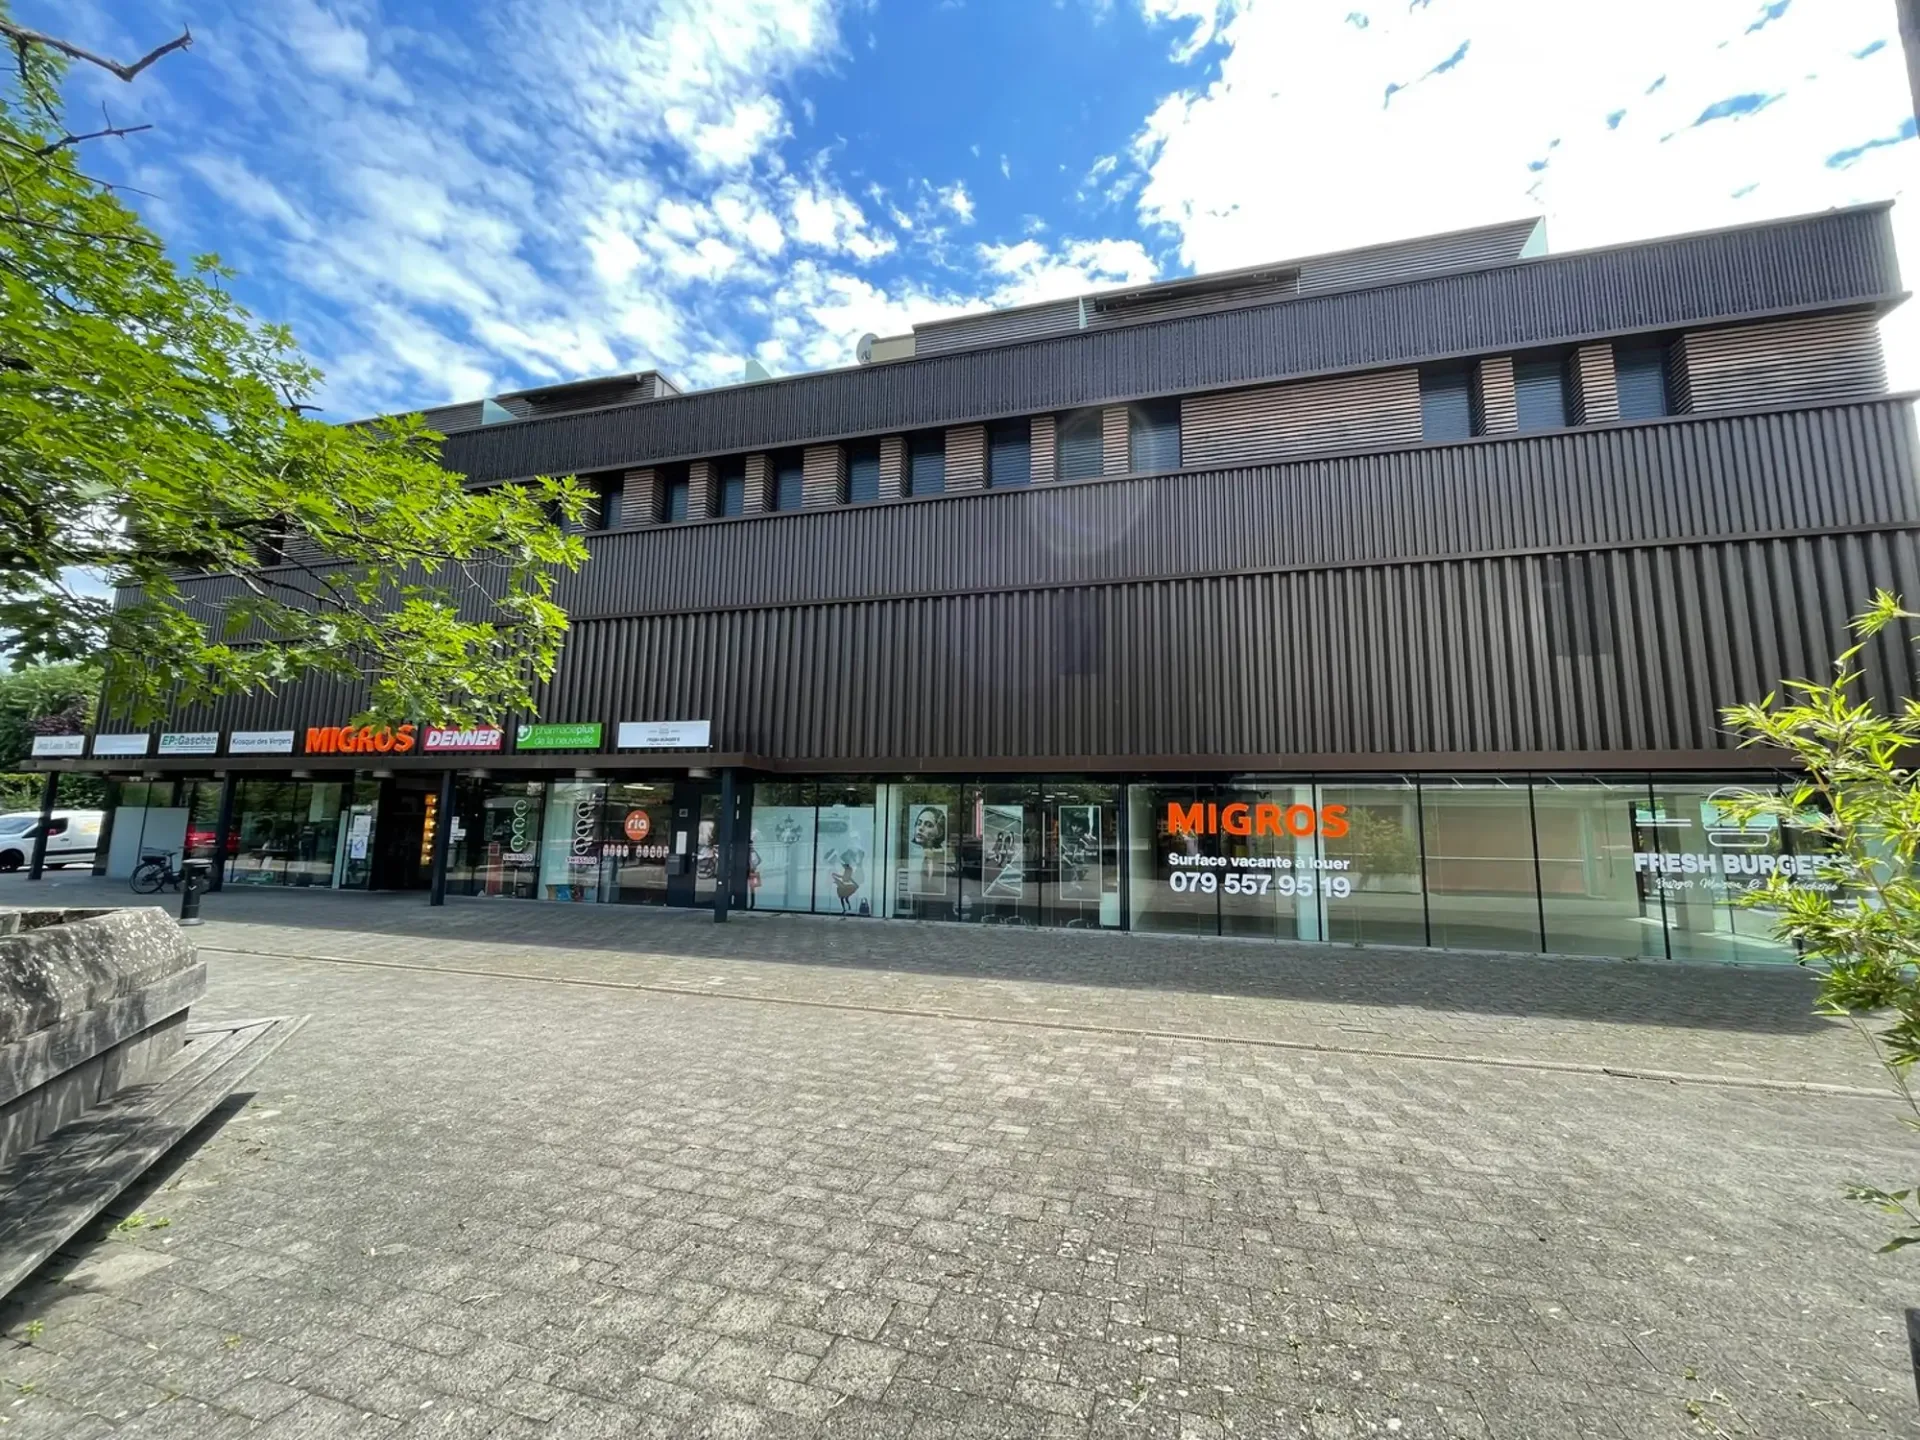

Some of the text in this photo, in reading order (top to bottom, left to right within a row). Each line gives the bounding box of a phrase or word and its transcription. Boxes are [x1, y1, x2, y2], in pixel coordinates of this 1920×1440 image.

[305, 724, 415, 753] MIGROS
[427, 729, 500, 747] DENNER
[535, 725, 595, 736] pharmacieplus
[232, 738, 256, 746] Kiosque
[269, 737, 291, 746] Vergers
[535, 737, 545, 746] de
[555, 736, 593, 746] neuveville
[628, 814, 647, 829] ria
[1168, 802, 1350, 838] MIGROS
[1168, 852, 1351, 871] Surface vacante à louer
[1634, 853, 1717, 873] FRESH
[1169, 871, 1351, 898] 079 557 95 19
